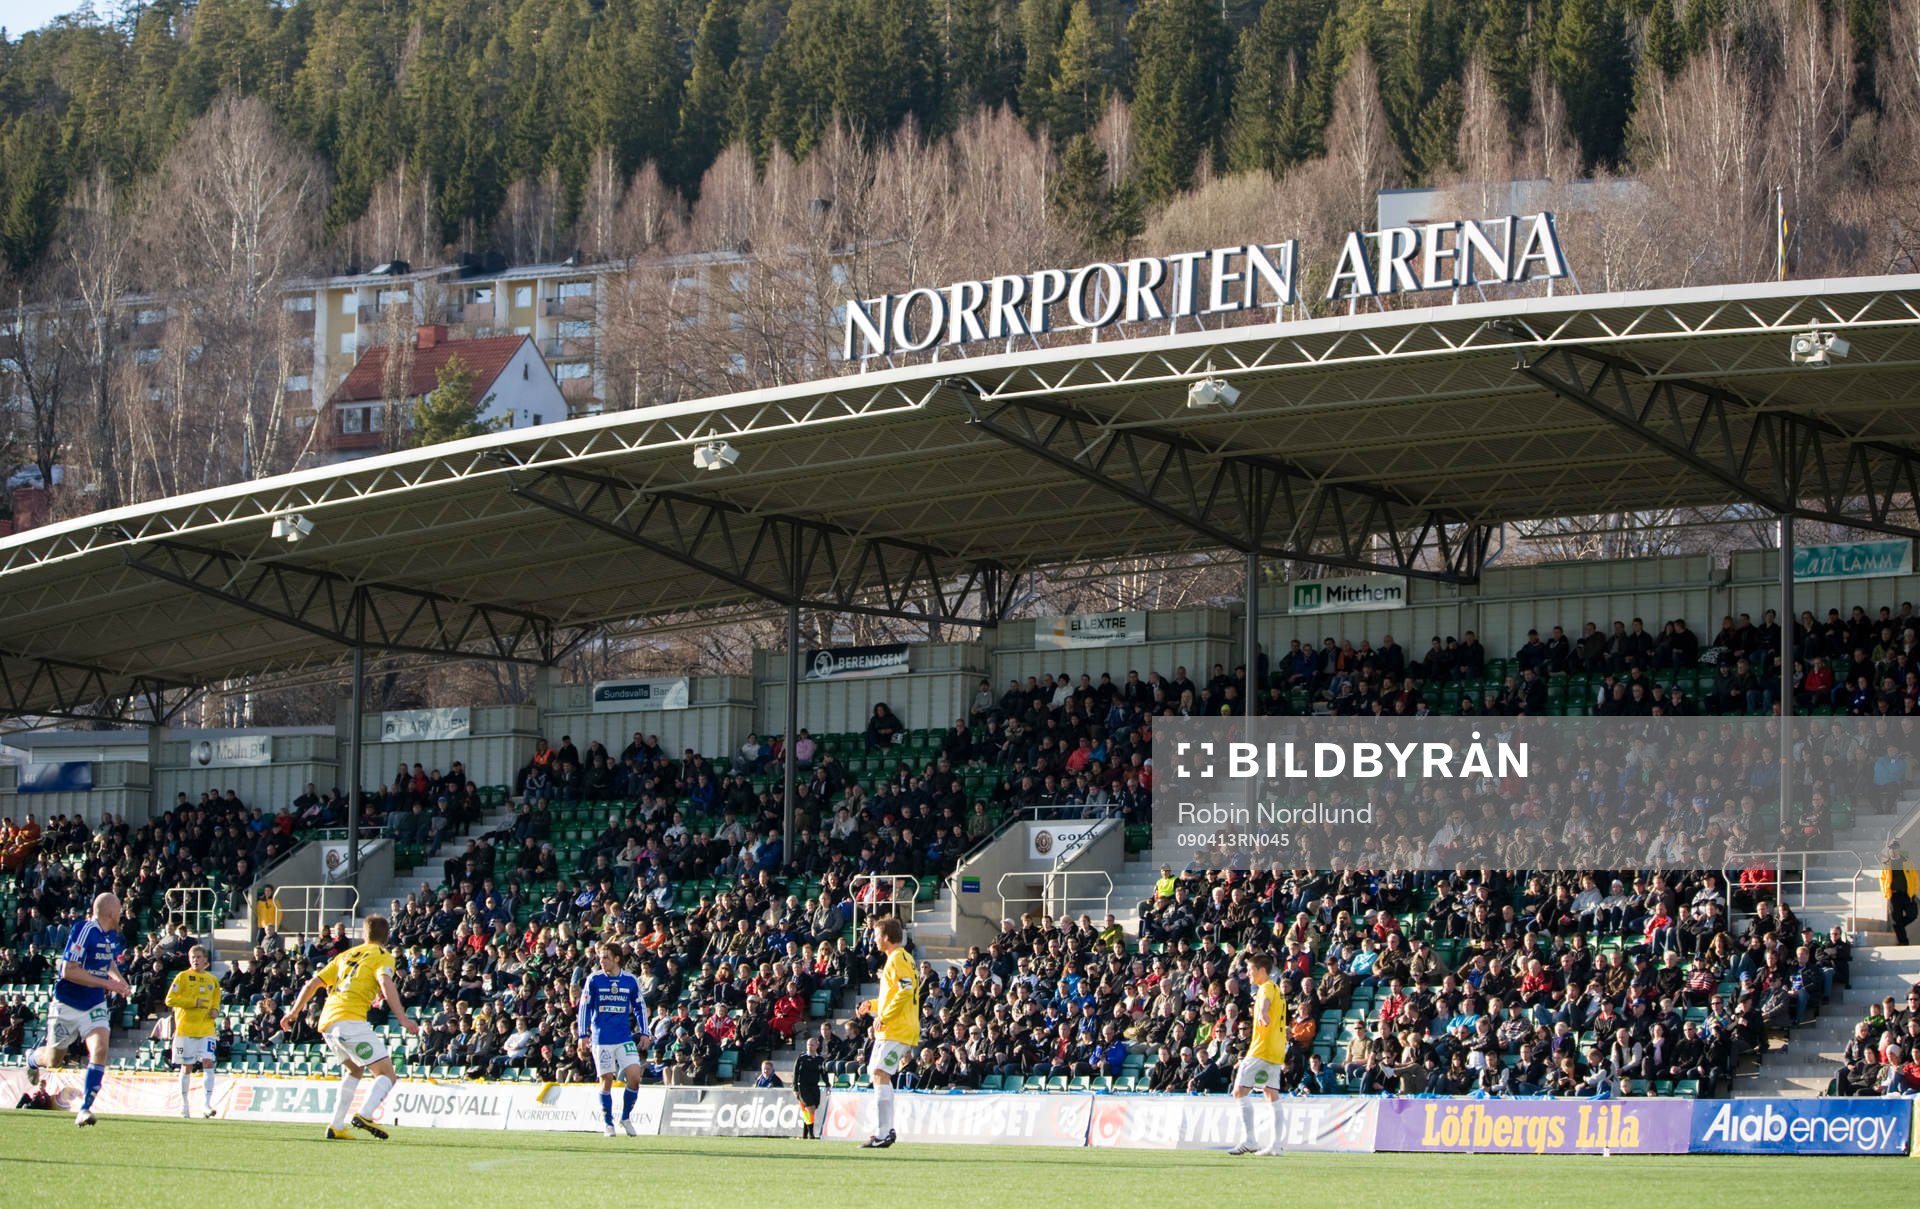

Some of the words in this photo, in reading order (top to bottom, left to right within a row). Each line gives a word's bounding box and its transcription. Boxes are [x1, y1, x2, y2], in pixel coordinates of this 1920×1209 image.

[843, 239, 1297, 361] NORRPORTEN
[1327, 211, 1567, 299] ARENA
[1793, 548, 1838, 576] Carl
[1842, 552, 1893, 571] LAMM
[1326, 583, 1402, 603] Mitthem
[1071, 616, 1126, 631] ELLEXTRE
[838, 653, 902, 669] BERENDSEN
[604, 687, 648, 699] Sundsvalls
[393, 1093, 501, 1116] SUNDSVALL
[515, 1108, 578, 1121] NORRPORTEN
[863, 1098, 1041, 1137] SRYKTIPSET
[1422, 1103, 1566, 1153] Löfbergs
[1576, 1104, 1640, 1148] Lila
[1790, 1116, 1897, 1150] energy
